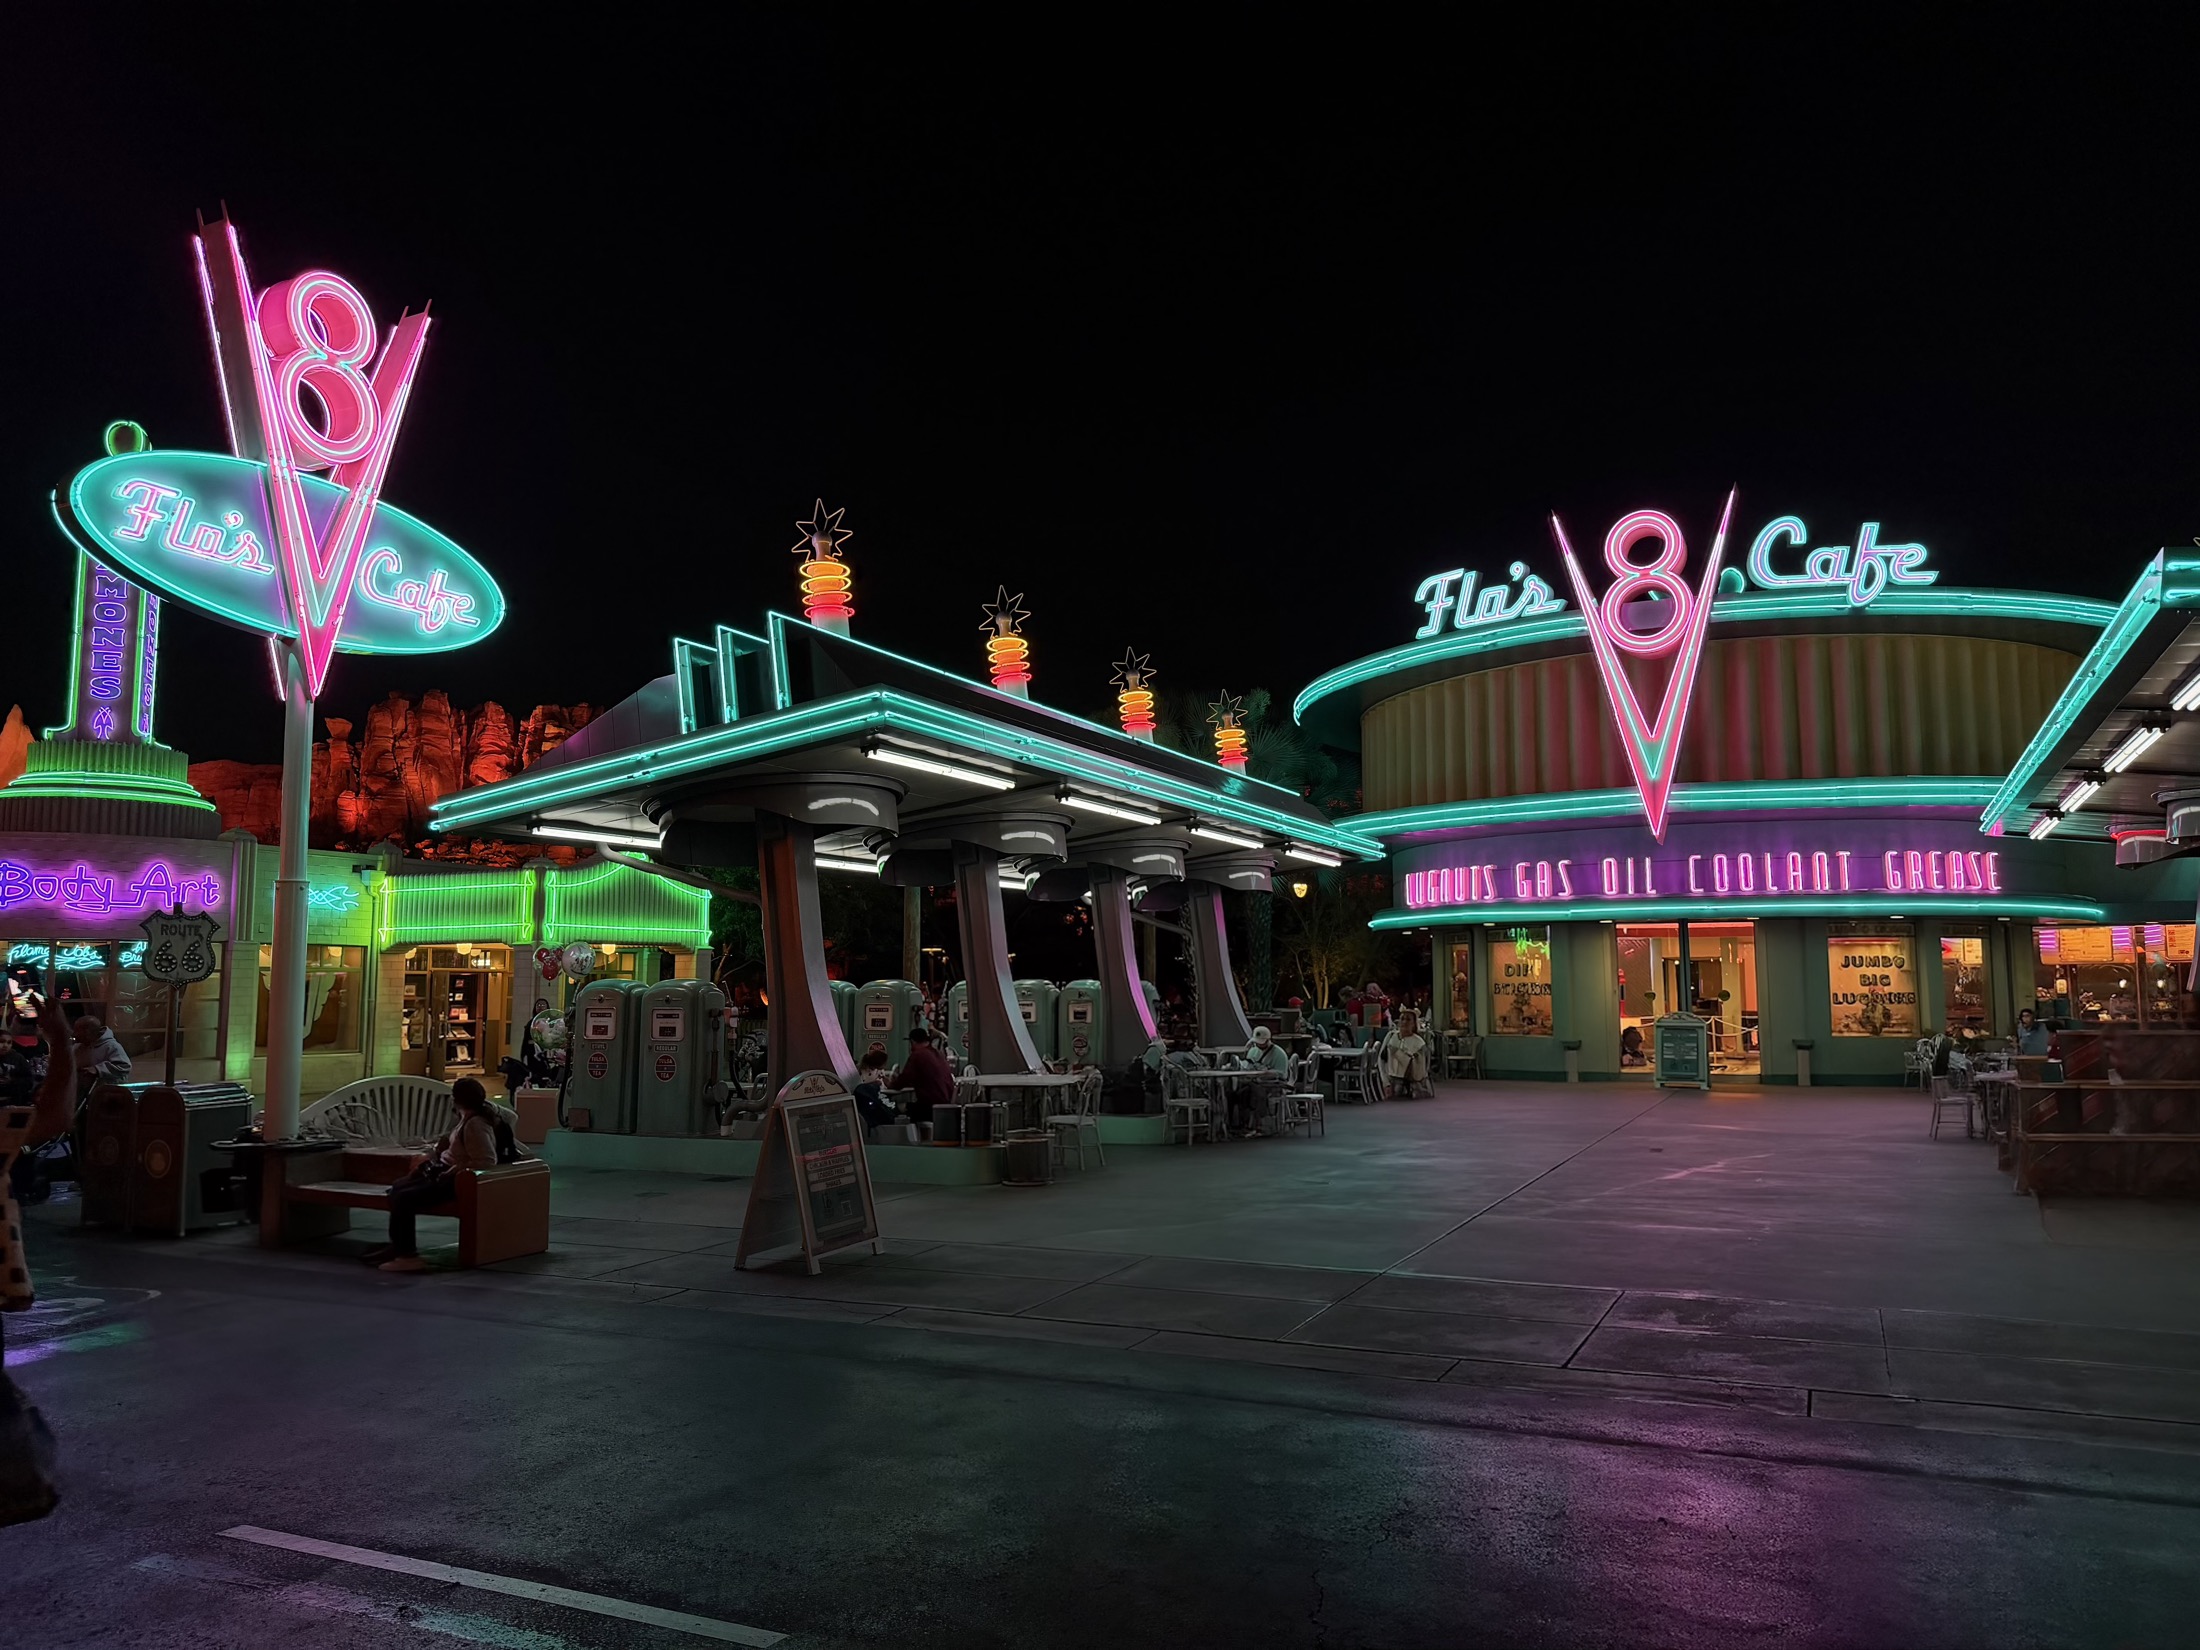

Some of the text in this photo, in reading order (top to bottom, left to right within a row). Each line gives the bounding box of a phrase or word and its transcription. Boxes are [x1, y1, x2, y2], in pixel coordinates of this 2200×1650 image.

[110, 476, 277, 577] Flo's
[356, 547, 482, 635] Cafe
[1413, 559, 1568, 639] Flo's
[1746, 514, 1939, 608] Cafe
[90, 566, 128, 700] MONES
[0, 862, 221, 913] Body Art
[1404, 849, 2003, 906] LUGNUTS GAS OIL COOLANT GREASE
[160, 923, 203, 938] ROUTE
[64, 944, 102, 960] Jobs
[154, 940, 205, 973] 66
[1841, 955, 1905, 968] JUMBO
[1859, 973, 1891, 987] BIG
